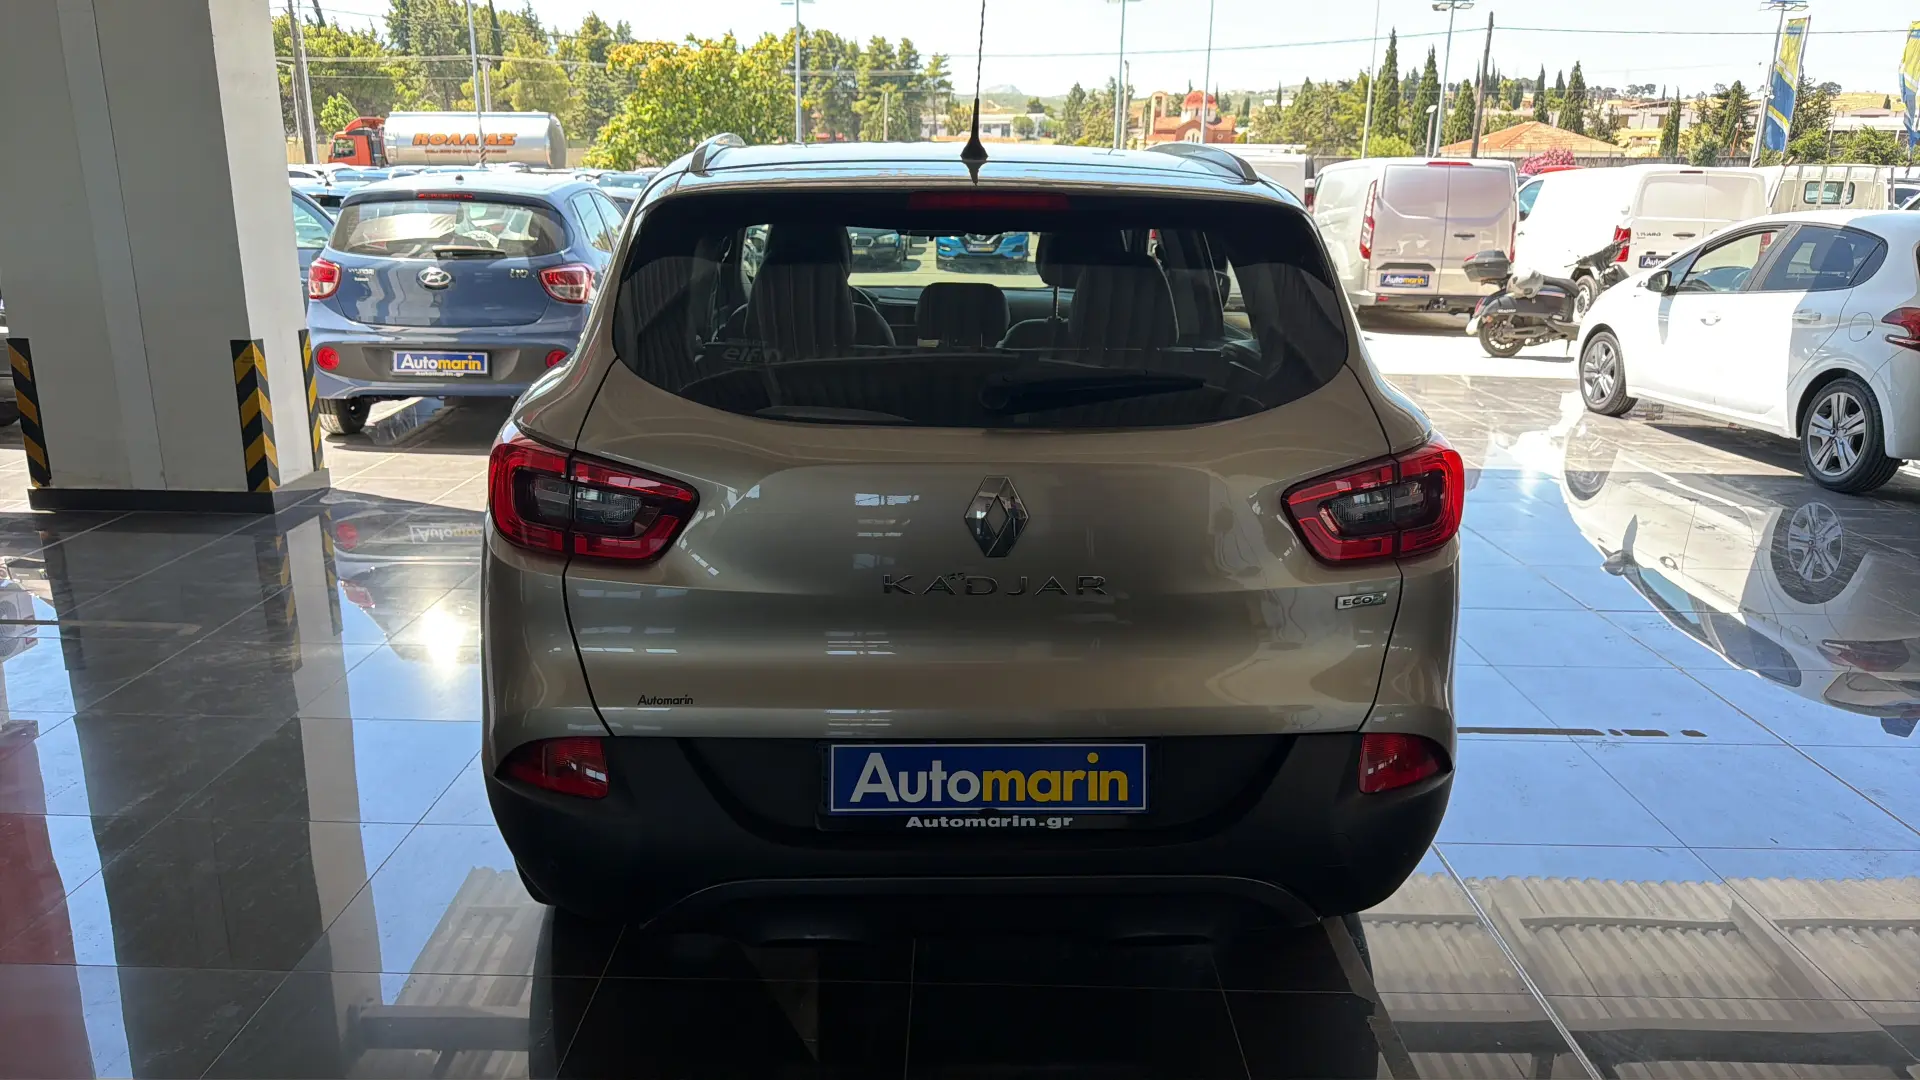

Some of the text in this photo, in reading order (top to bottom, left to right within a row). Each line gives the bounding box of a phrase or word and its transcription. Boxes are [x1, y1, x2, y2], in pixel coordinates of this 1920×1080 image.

[400, 353, 482, 371] Automarin
[883, 574, 1108, 596] KADJAR
[637, 694, 694, 706] Automarin
[850, 752, 1129, 803] Automarin
[905, 815, 1074, 829] Automarin.gr
